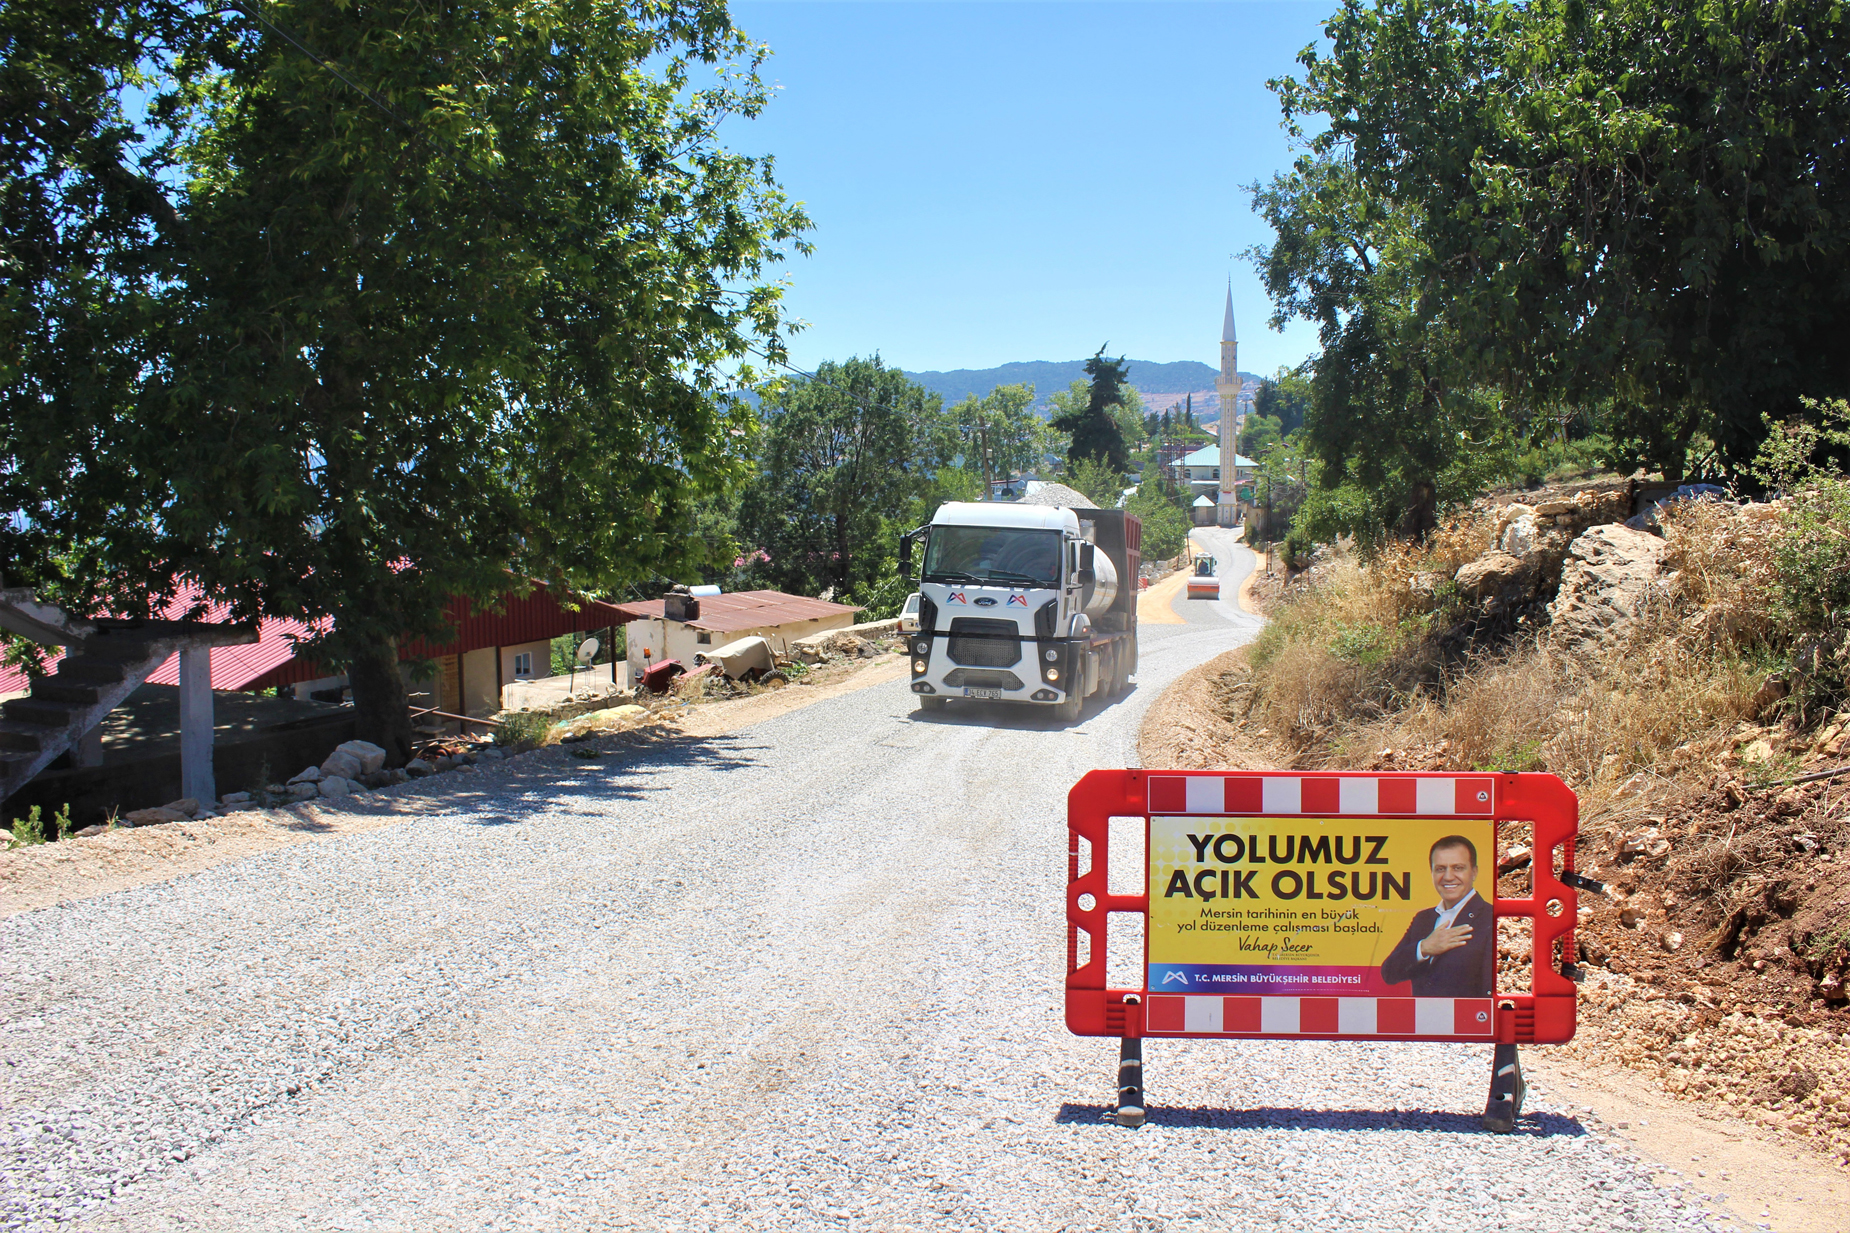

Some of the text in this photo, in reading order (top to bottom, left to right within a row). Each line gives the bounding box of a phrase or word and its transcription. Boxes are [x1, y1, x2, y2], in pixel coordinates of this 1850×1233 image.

[1186, 833, 1389, 865] YOLUMUZ
[1164, 869, 1411, 902] AÇIK OLSUN
[1200, 908, 1360, 923] Mersin tarihinin en büyük
[1177, 920, 1383, 935] yol düzenleme çalışması başladı.
[1239, 934, 1313, 959] Vahap Seçer
[1194, 973, 1361, 985] T.C. MERSİN BÜYÜKŞEHİR BELEDİYESİ
